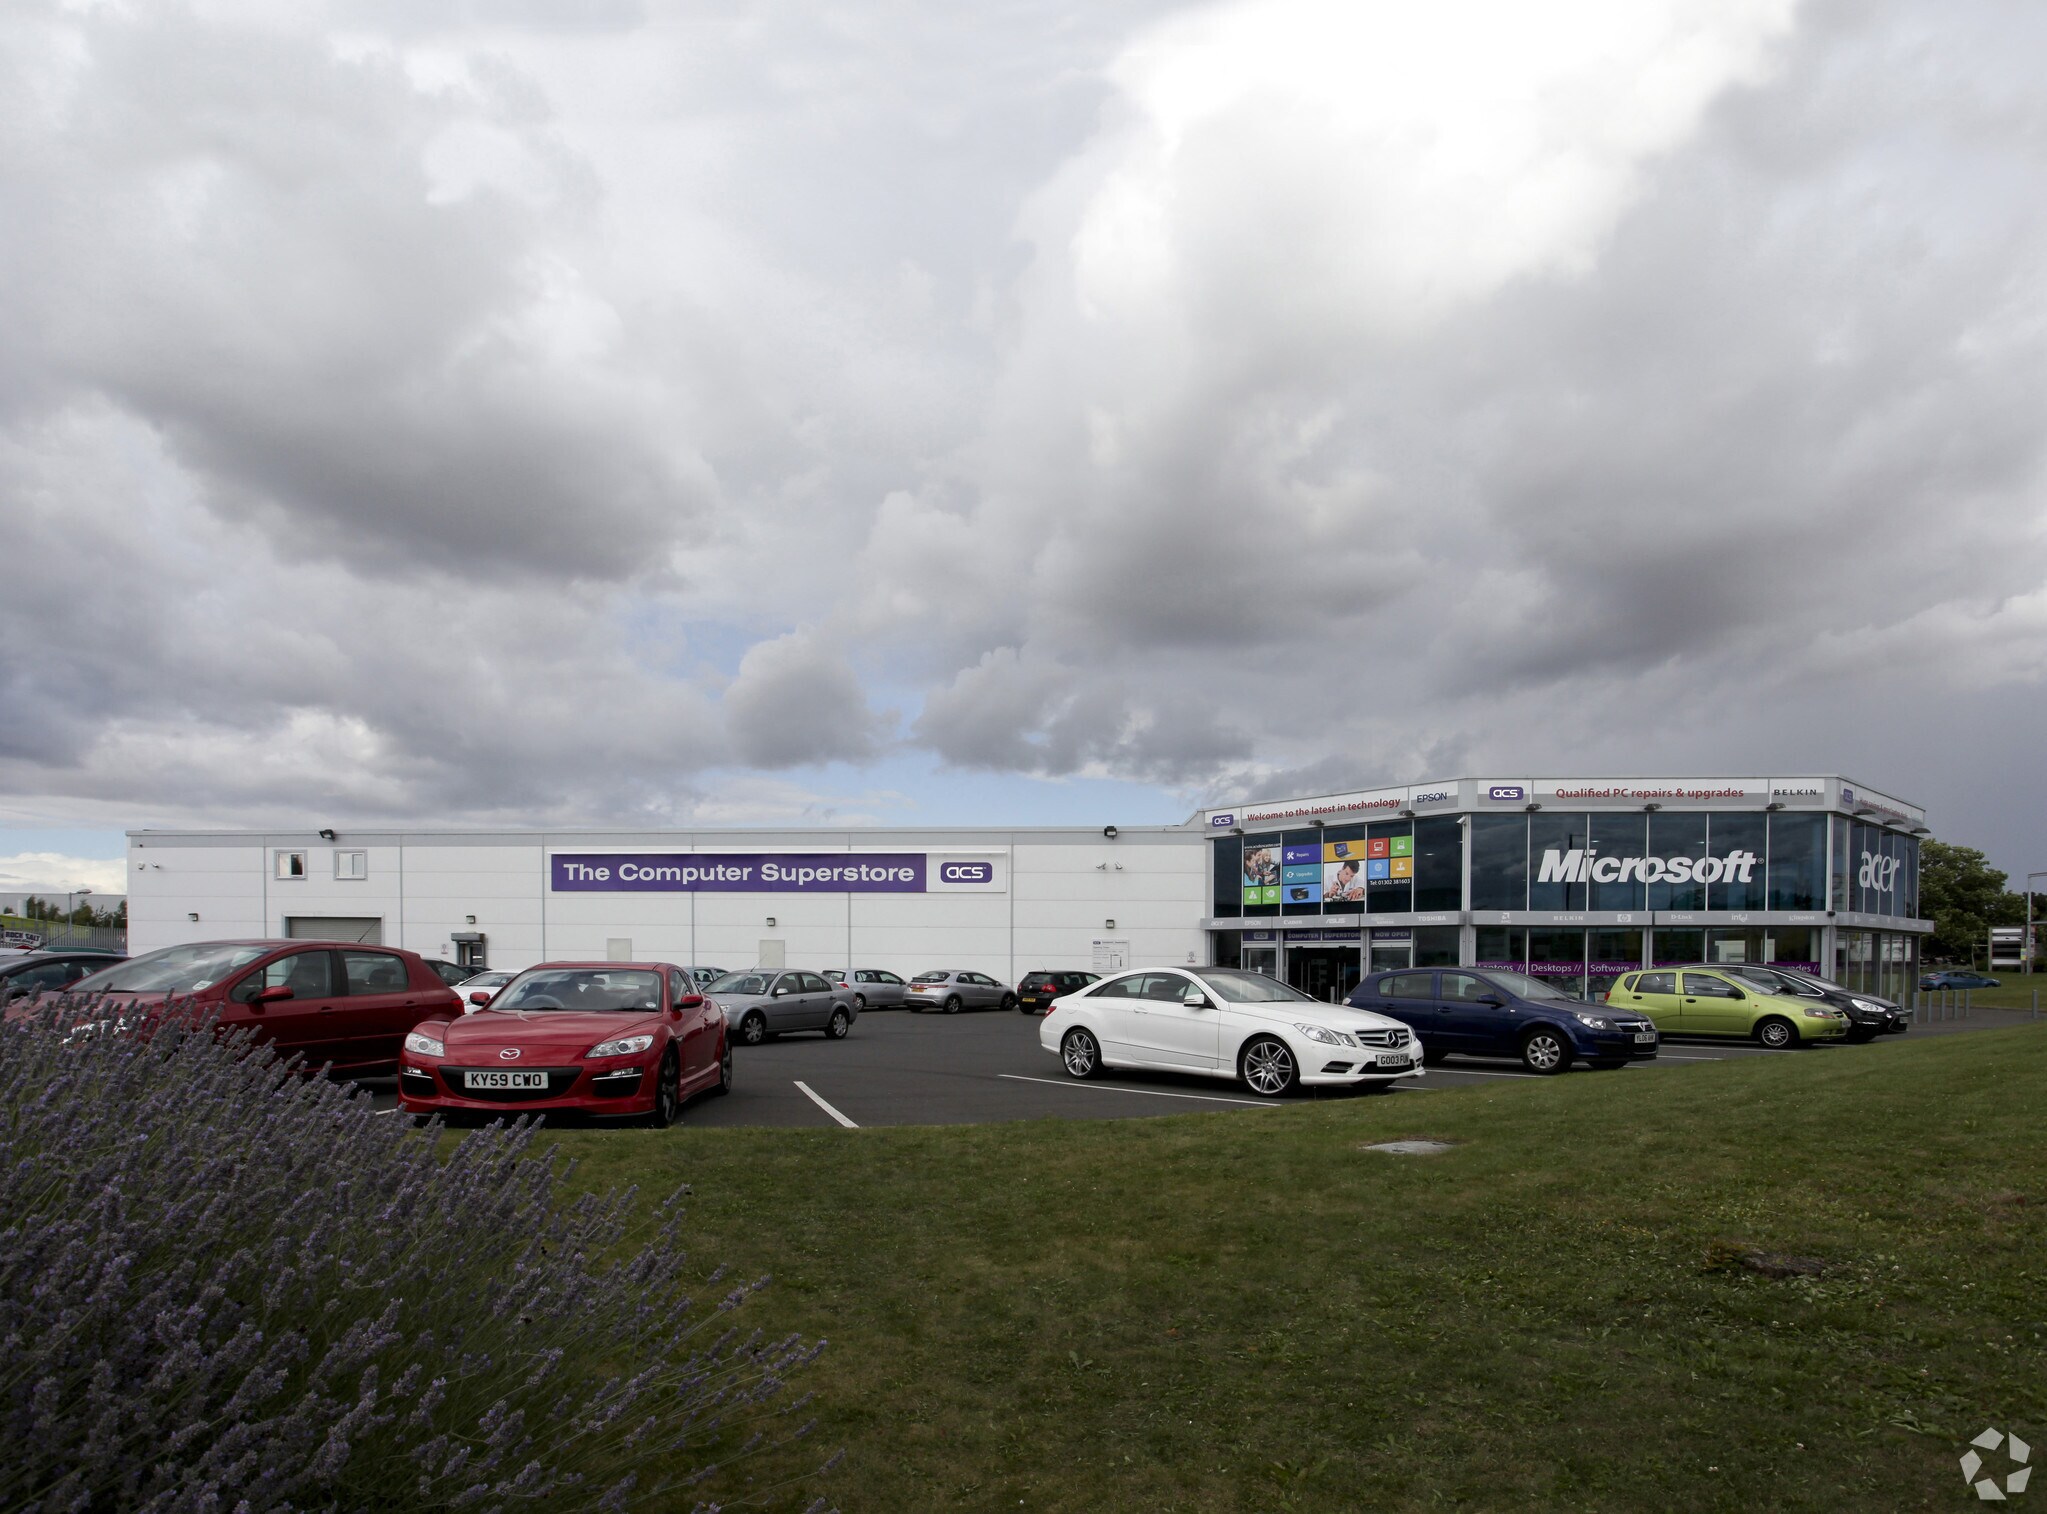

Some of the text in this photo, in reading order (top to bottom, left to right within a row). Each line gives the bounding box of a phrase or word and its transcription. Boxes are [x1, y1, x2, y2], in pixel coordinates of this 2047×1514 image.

[1417, 792, 1447, 803] EPSON
[1493, 789, 1518, 797] acs
[1556, 788, 1744, 800] Qualified PC repairs & upgrades
[1247, 799, 1401, 821] Welcome to the latest in technology
[1214, 816, 1231, 825] acs
[946, 865, 982, 879] acs
[1537, 849, 1757, 884] Microsoft
[1859, 851, 1900, 892] acer
[563, 863, 915, 886] The Computer Superstore
[1531, 963, 1572, 973] Desktops
[1590, 963, 1630, 972] Software
[471, 1073, 542, 1086] KY59 CWO
